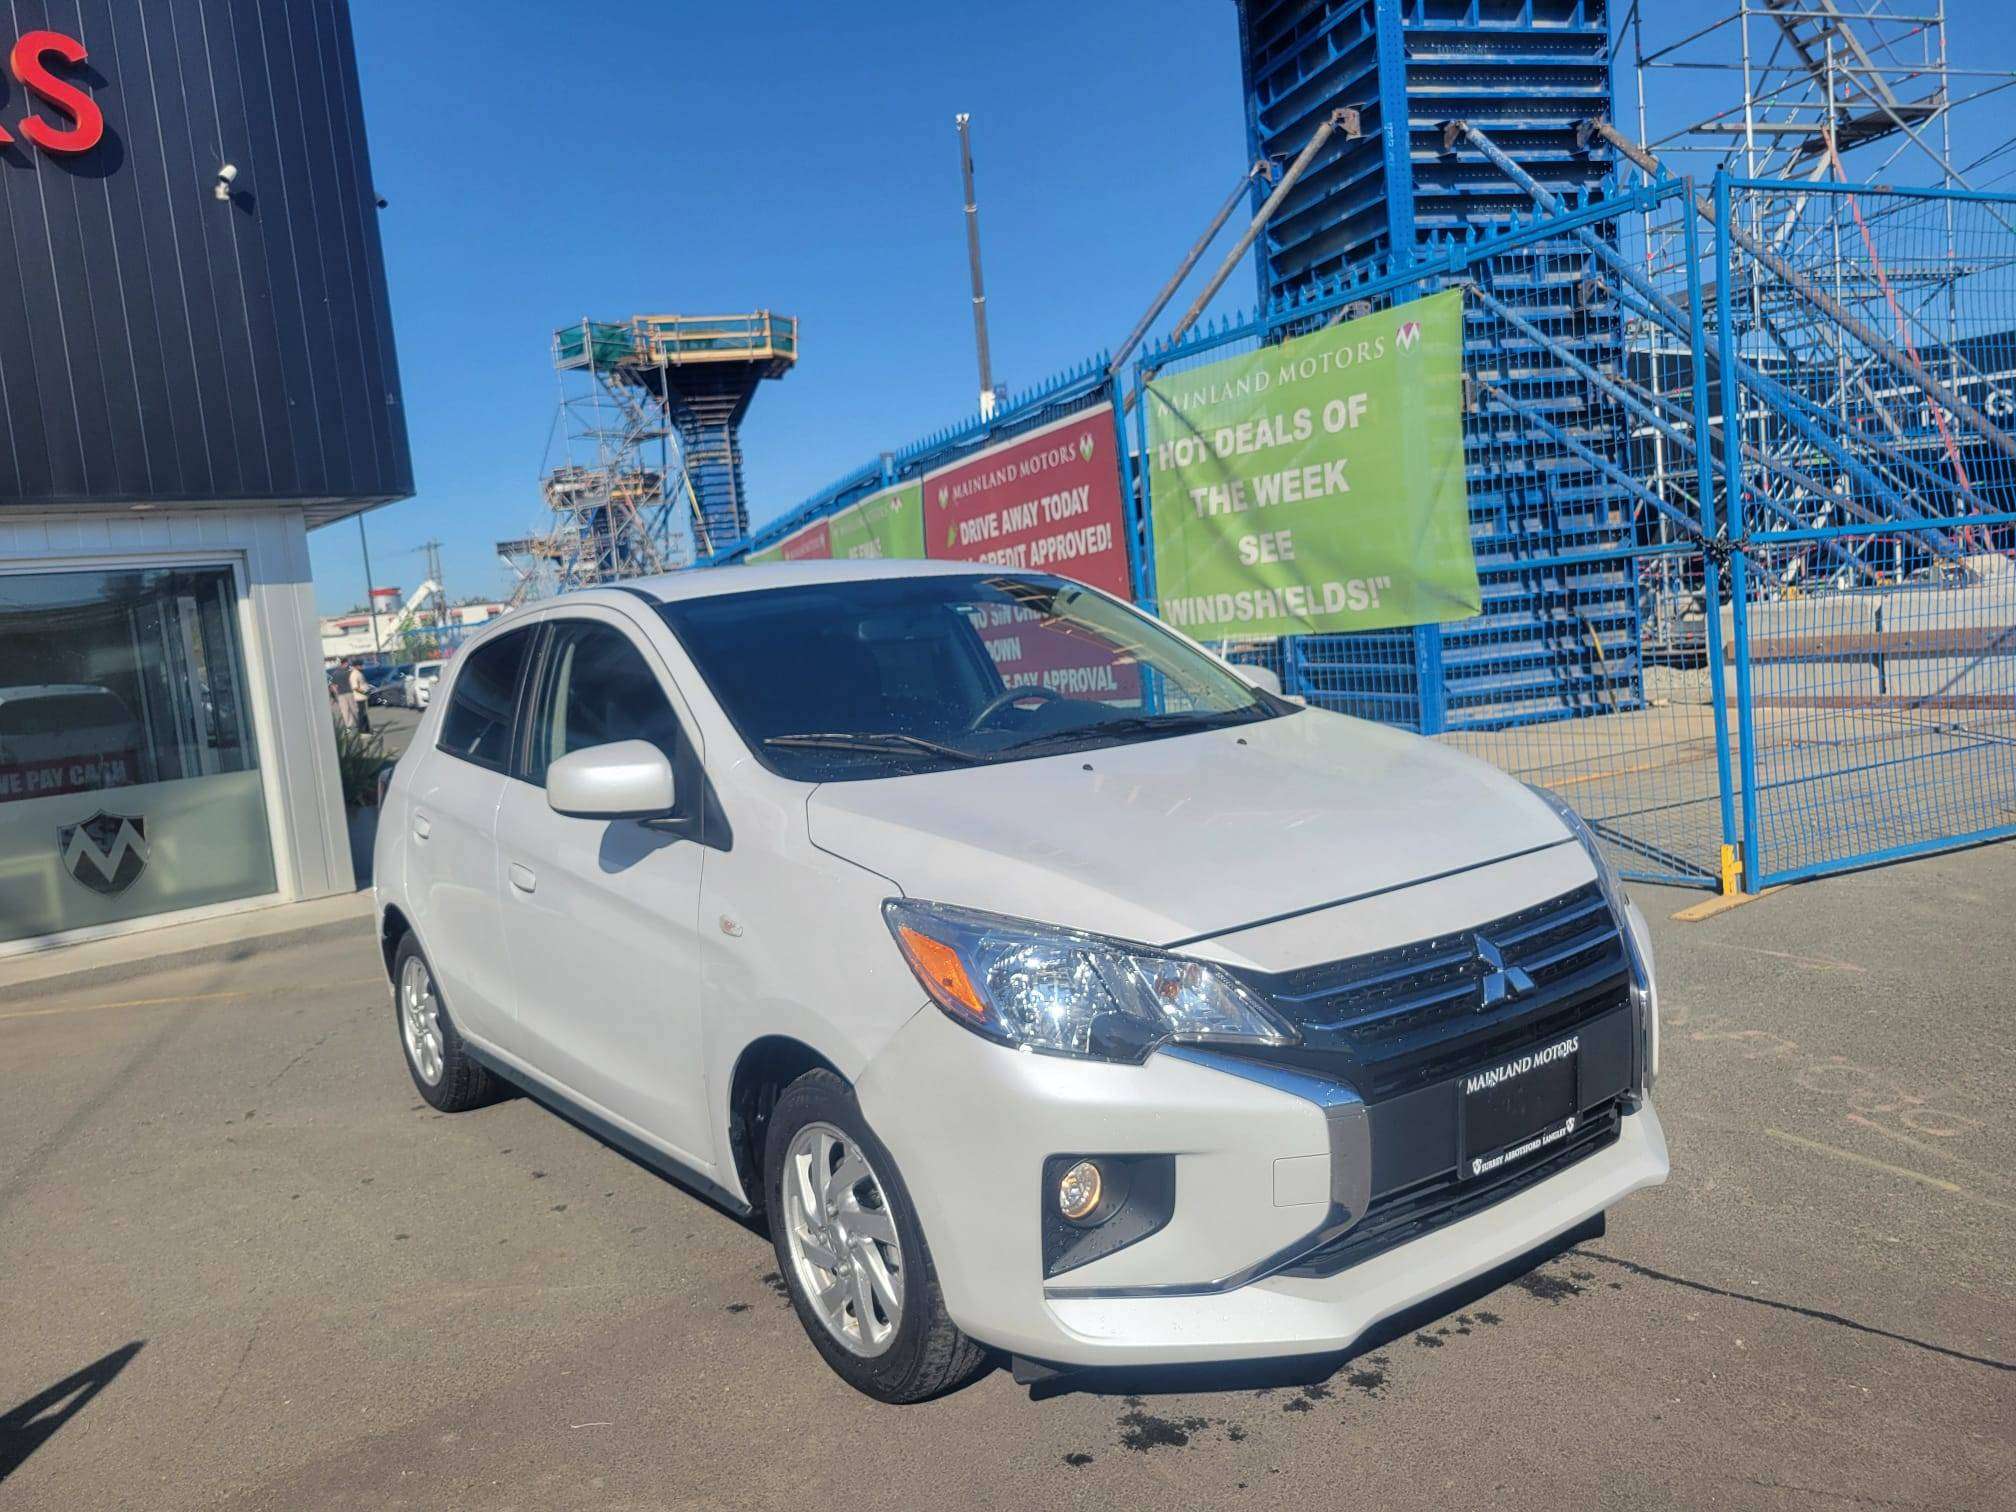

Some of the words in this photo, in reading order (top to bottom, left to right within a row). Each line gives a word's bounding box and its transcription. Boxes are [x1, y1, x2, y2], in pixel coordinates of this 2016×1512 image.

[0, 30, 104, 152] S
[1279, 337, 1385, 387] MOTORS
[1159, 433, 1206, 471] HOT
[1215, 408, 1312, 457] DEALS
[1323, 393, 1368, 433] OF
[953, 465, 1017, 499] MAINLAND
[1019, 443, 1076, 478] MOTORS
[1190, 482, 1248, 518] THE
[1252, 459, 1350, 506] WEEK
[960, 513, 999, 545] DRIVE
[1002, 500, 1039, 535] AWAY
[1042, 485, 1090, 523] TODAY
[1031, 523, 1112, 567] APPROVED!
[1238, 530, 1296, 566] SEE
[1164, 576, 1392, 626] WINDSHIELDS!"
[1042, 665, 1117, 693] APPROVAL
[26, 768, 63, 791] PAY
[1466, 1057, 1532, 1094] MAINLAND
[1533, 1036, 1579, 1068] MOTORS
